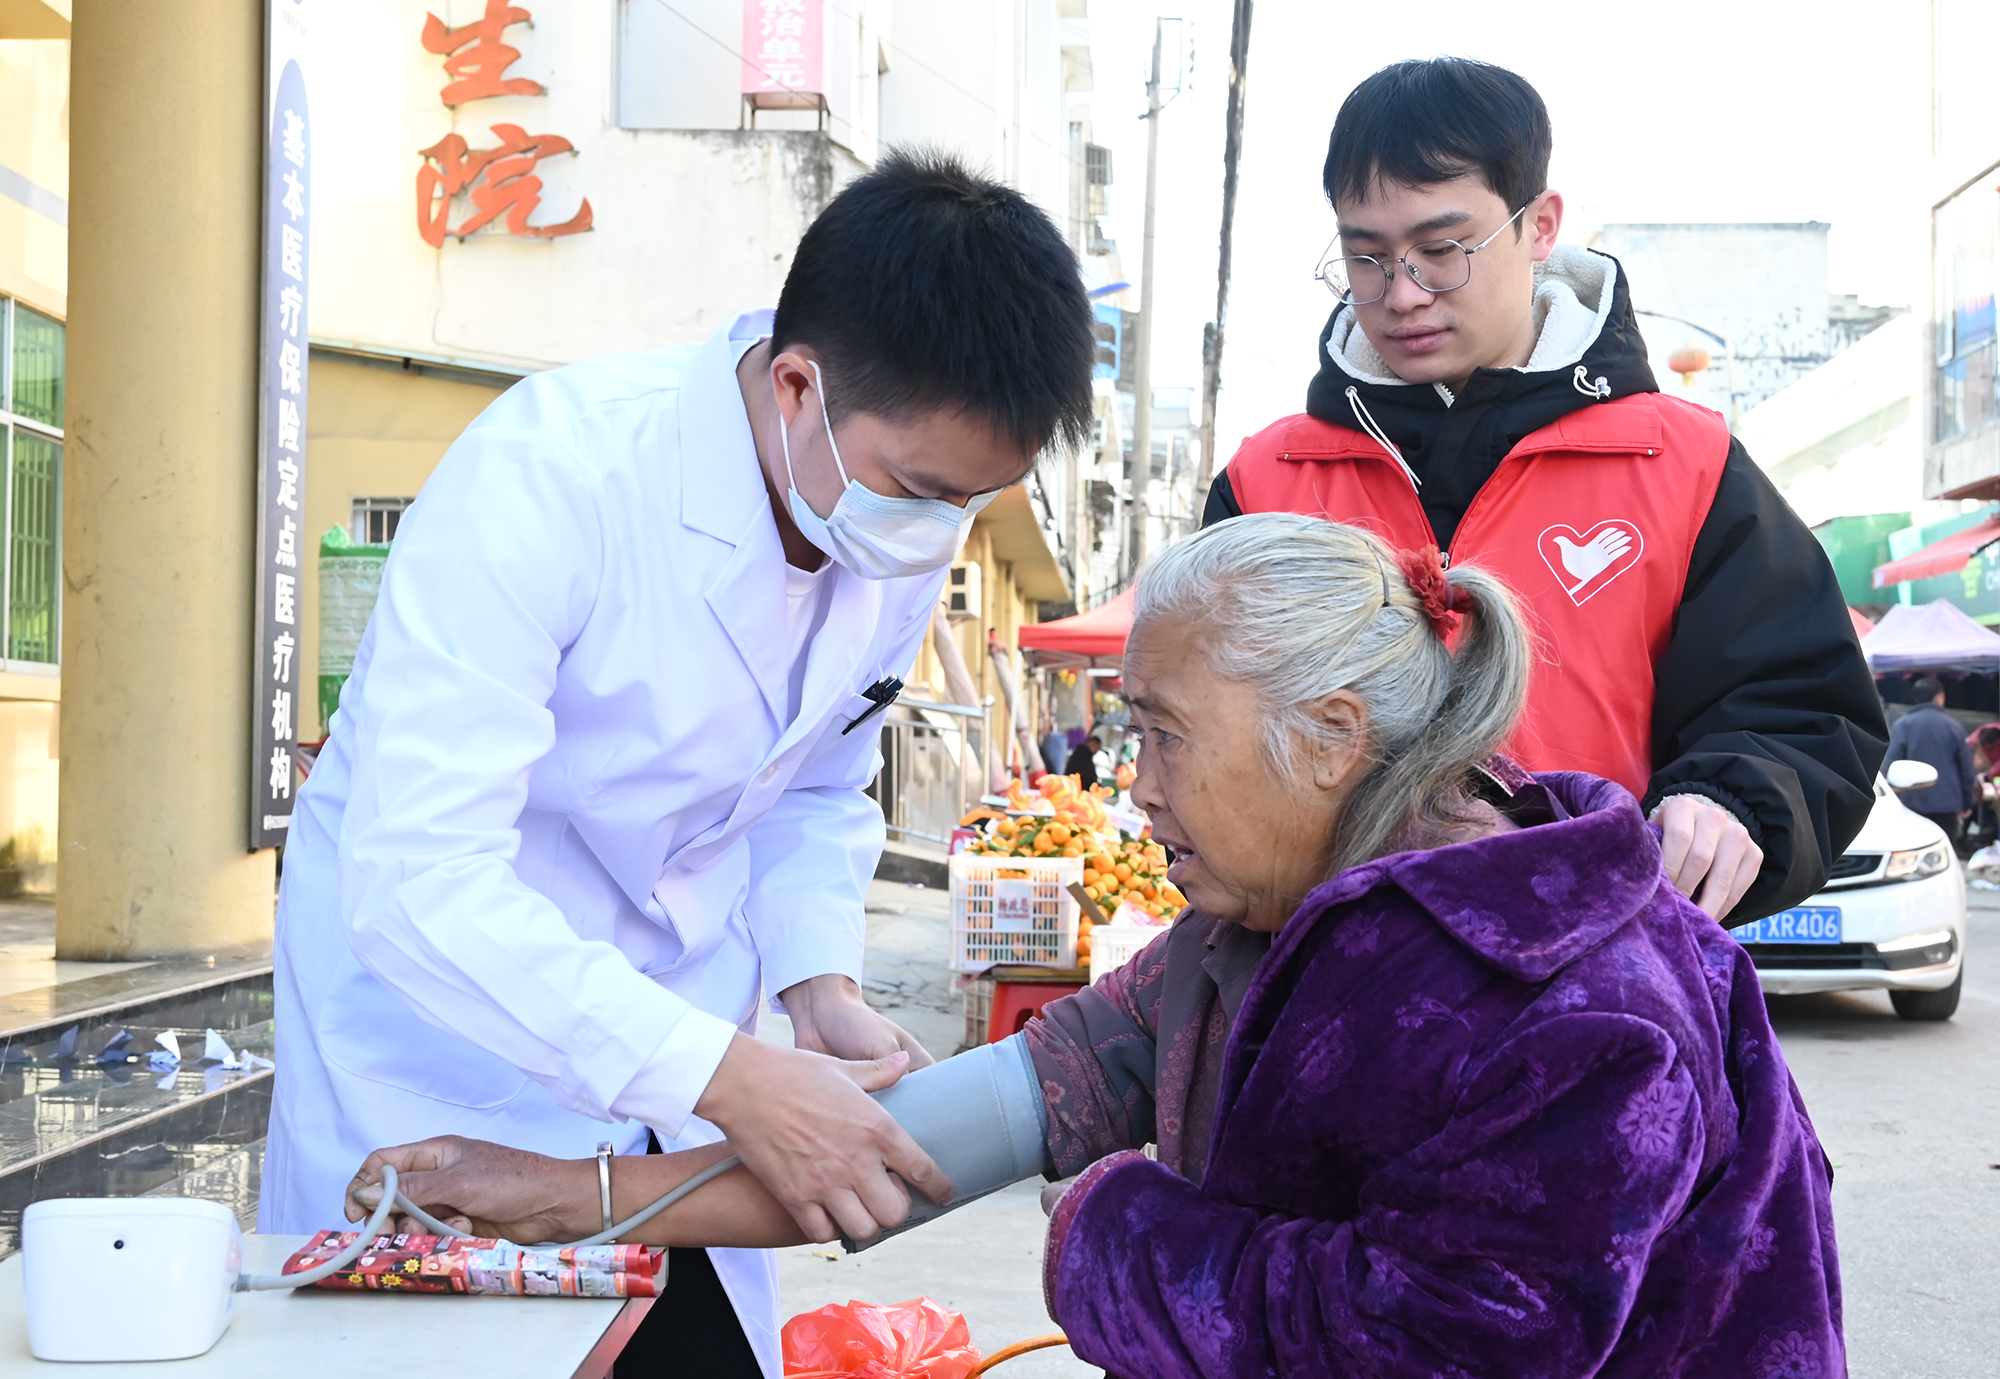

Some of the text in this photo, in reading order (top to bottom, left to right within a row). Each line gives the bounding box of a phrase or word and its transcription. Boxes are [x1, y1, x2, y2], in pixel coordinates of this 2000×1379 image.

[416, 0, 594, 249] 生院
[269, 108, 306, 800] 基本医疗保险定点医疗机构
